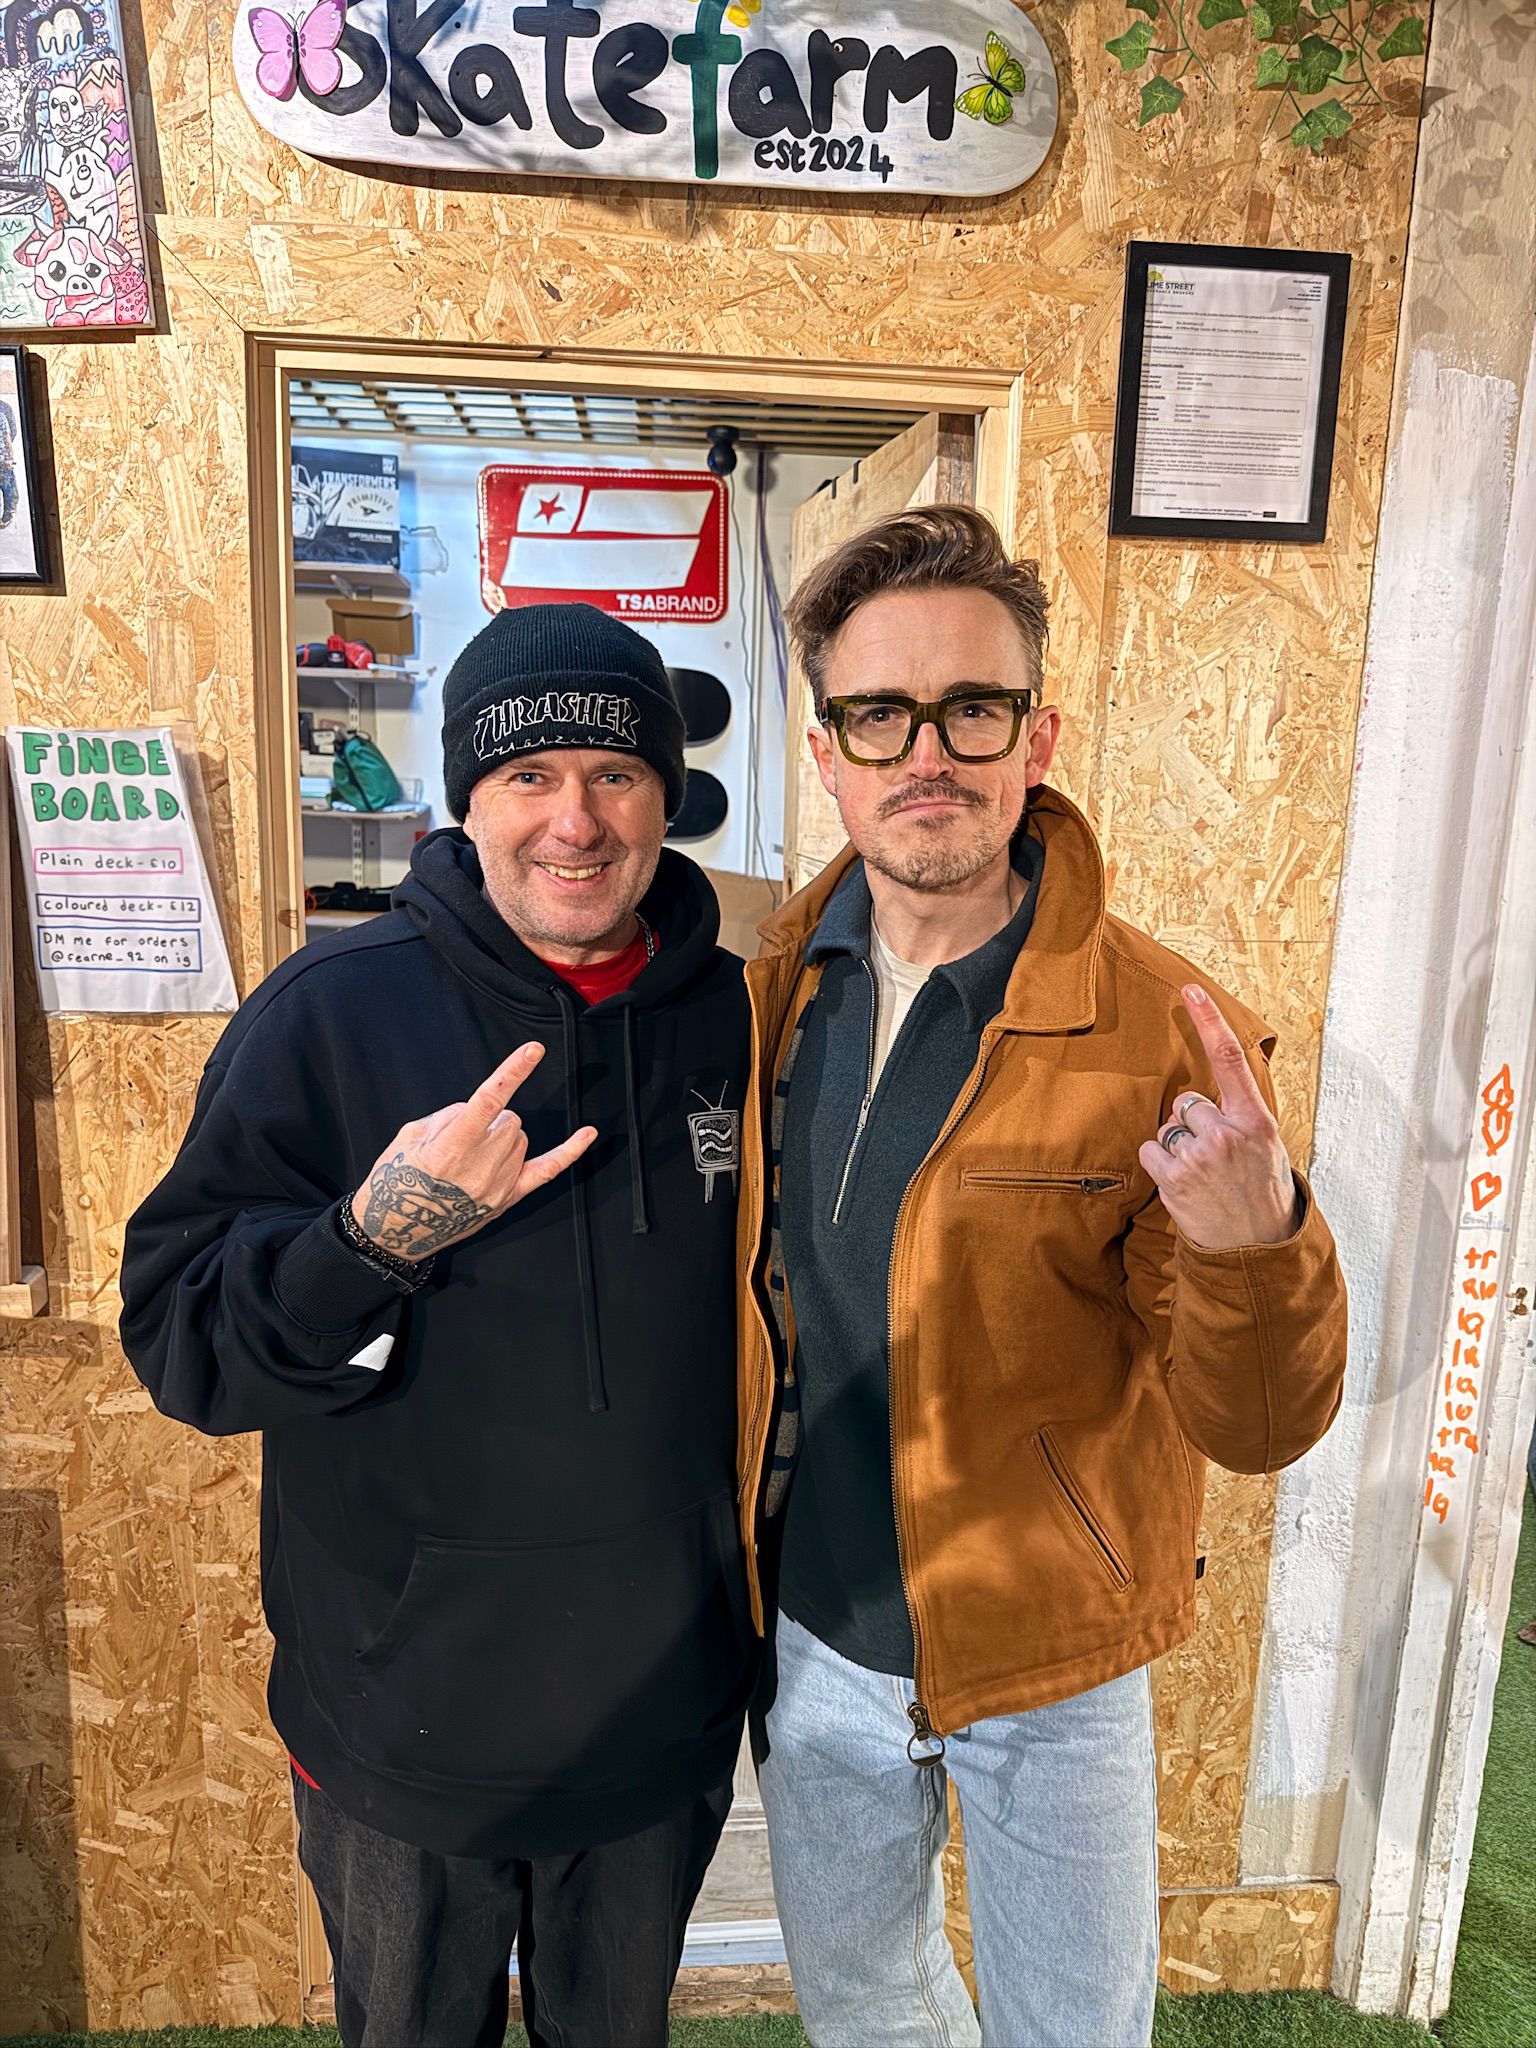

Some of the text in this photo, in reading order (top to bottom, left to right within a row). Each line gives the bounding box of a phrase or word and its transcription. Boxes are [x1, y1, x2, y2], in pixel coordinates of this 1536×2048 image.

[1165, 282, 1195, 291] STREET
[321, 470, 396, 490] TRANSFORMERS
[346, 493, 394, 512] PRIMITIVE
[473, 692, 641, 761] THRASHER
[492, 735, 615, 756] MAGAZINE
[40, 852, 83, 867] Plain
[43, 932, 65, 945] DM
[73, 936, 92, 946] me
[138, 935, 189, 947] orders
[154, 954, 169, 964] on
[176, 952, 191, 967] ig
